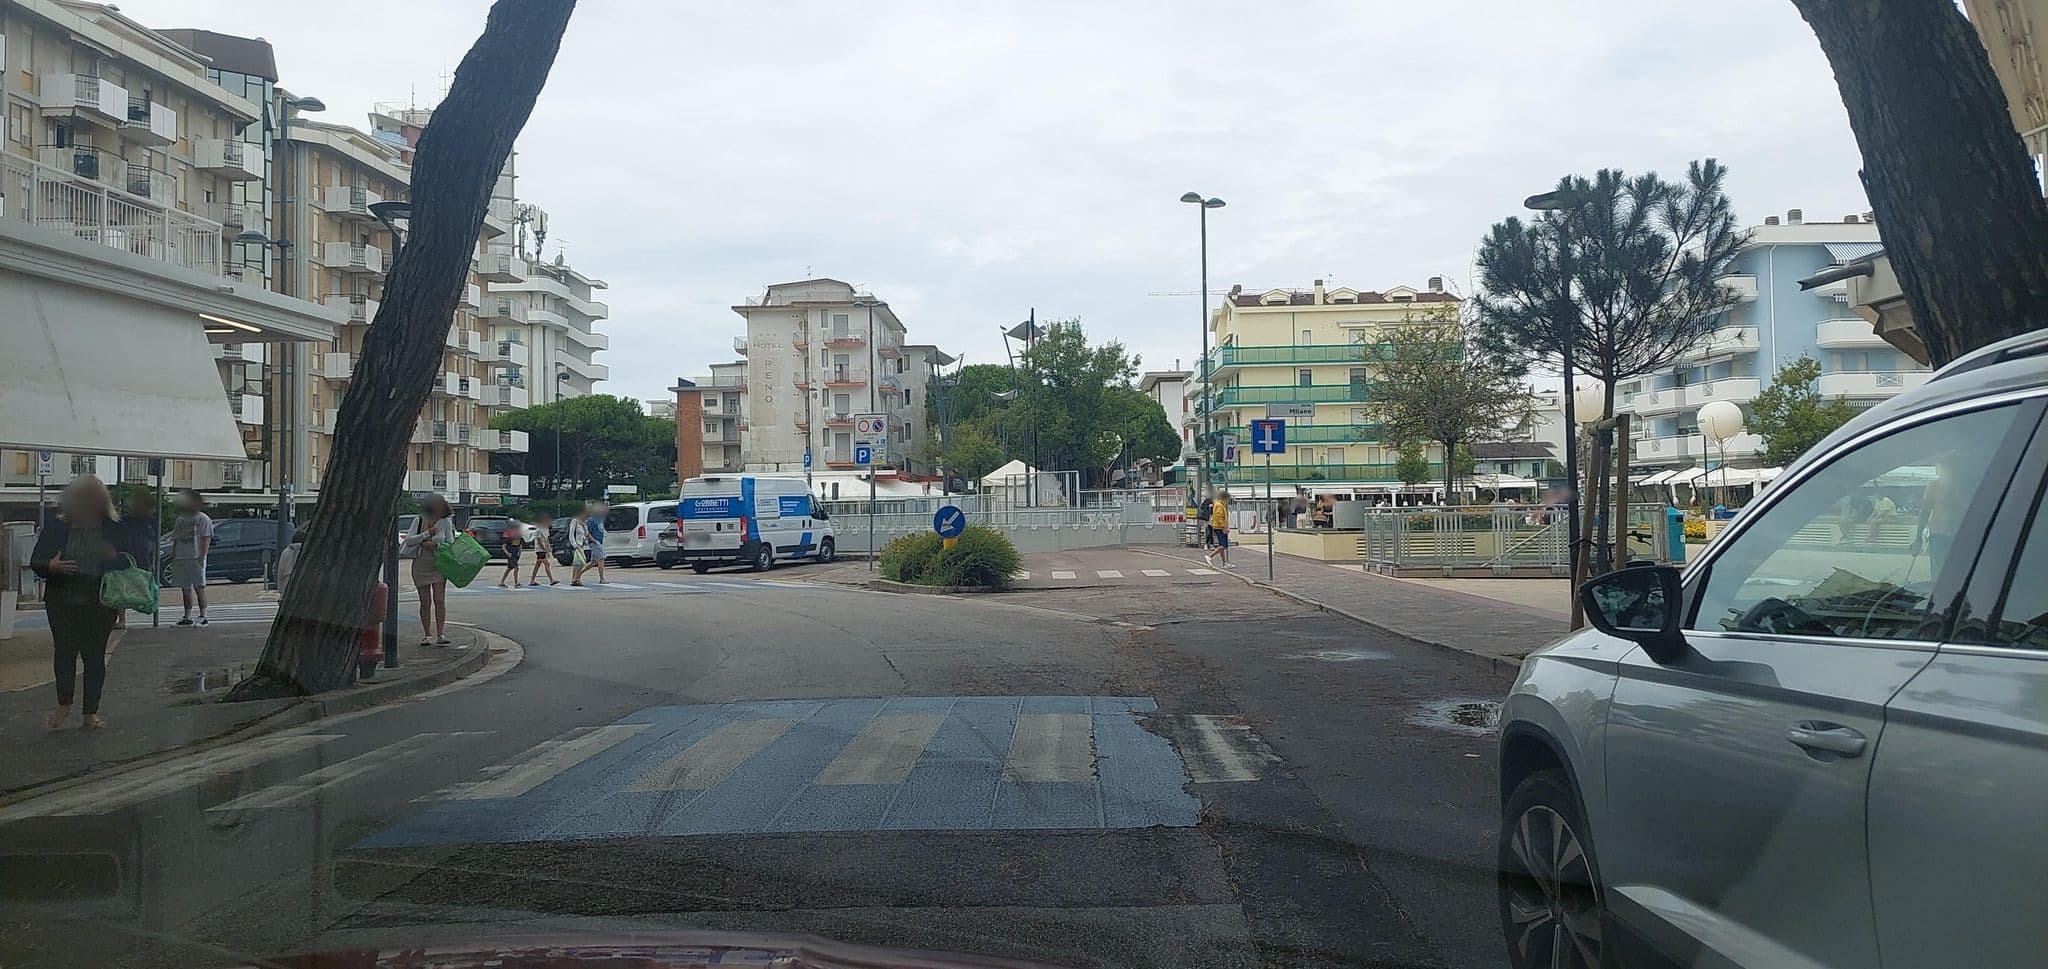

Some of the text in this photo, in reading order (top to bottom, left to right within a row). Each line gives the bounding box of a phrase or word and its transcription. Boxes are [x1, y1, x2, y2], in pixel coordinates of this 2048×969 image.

[805, 455, 810, 465] P
[859, 450, 867, 461] P
[695, 499, 729, 507] GOBBETTI
